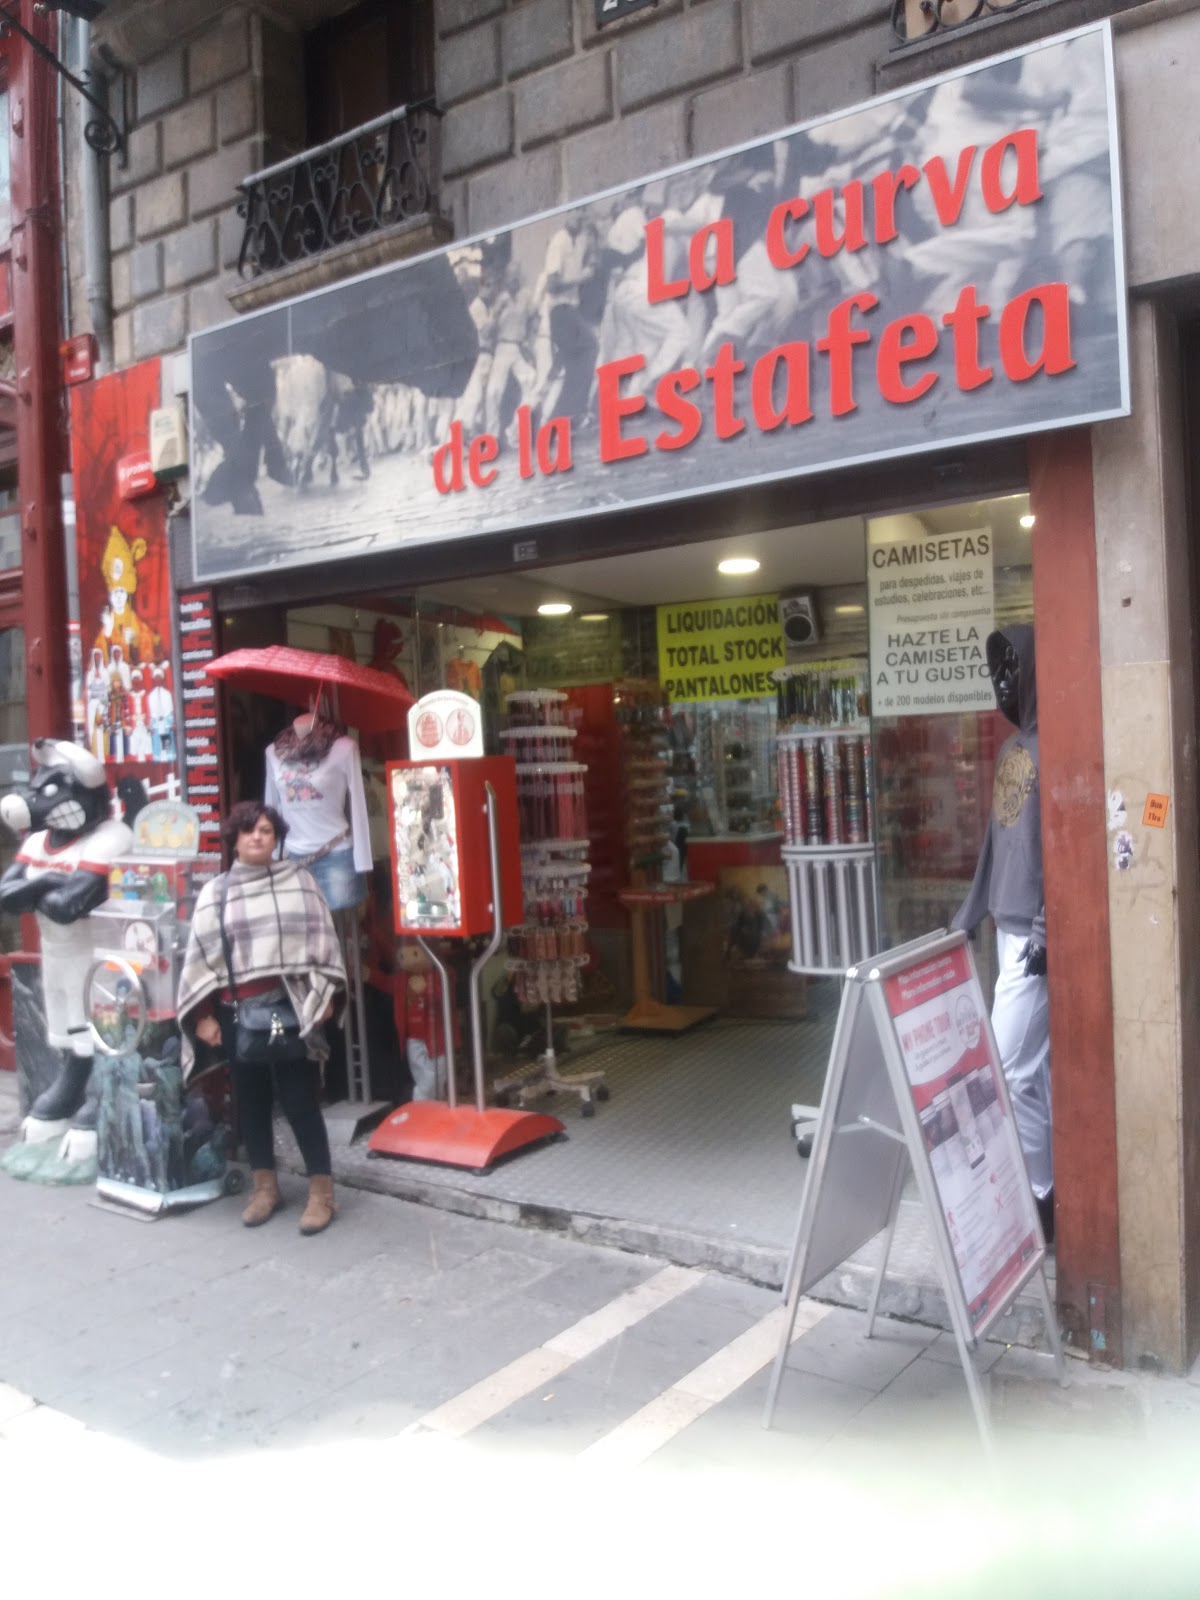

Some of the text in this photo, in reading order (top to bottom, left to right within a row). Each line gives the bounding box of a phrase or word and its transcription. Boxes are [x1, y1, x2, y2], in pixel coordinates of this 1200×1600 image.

[644, 128, 1043, 305] La curva
[432, 281, 1077, 495] de la Estafeta
[872, 534, 990, 569] CAMISETAS
[879, 577, 897, 592] para
[973, 568, 984, 580] de
[667, 599, 779, 634] LIQUIDACIÓN
[887, 626, 979, 648] HAZTE LA
[666, 636, 783, 667] TOTAL STOCK
[886, 645, 982, 667] CAMISETA
[664, 671, 779, 698] PANTALONES
[877, 663, 992, 686] A TU GUSTO
[896, 694, 910, 706] 200
[913, 692, 945, 705] modelos
